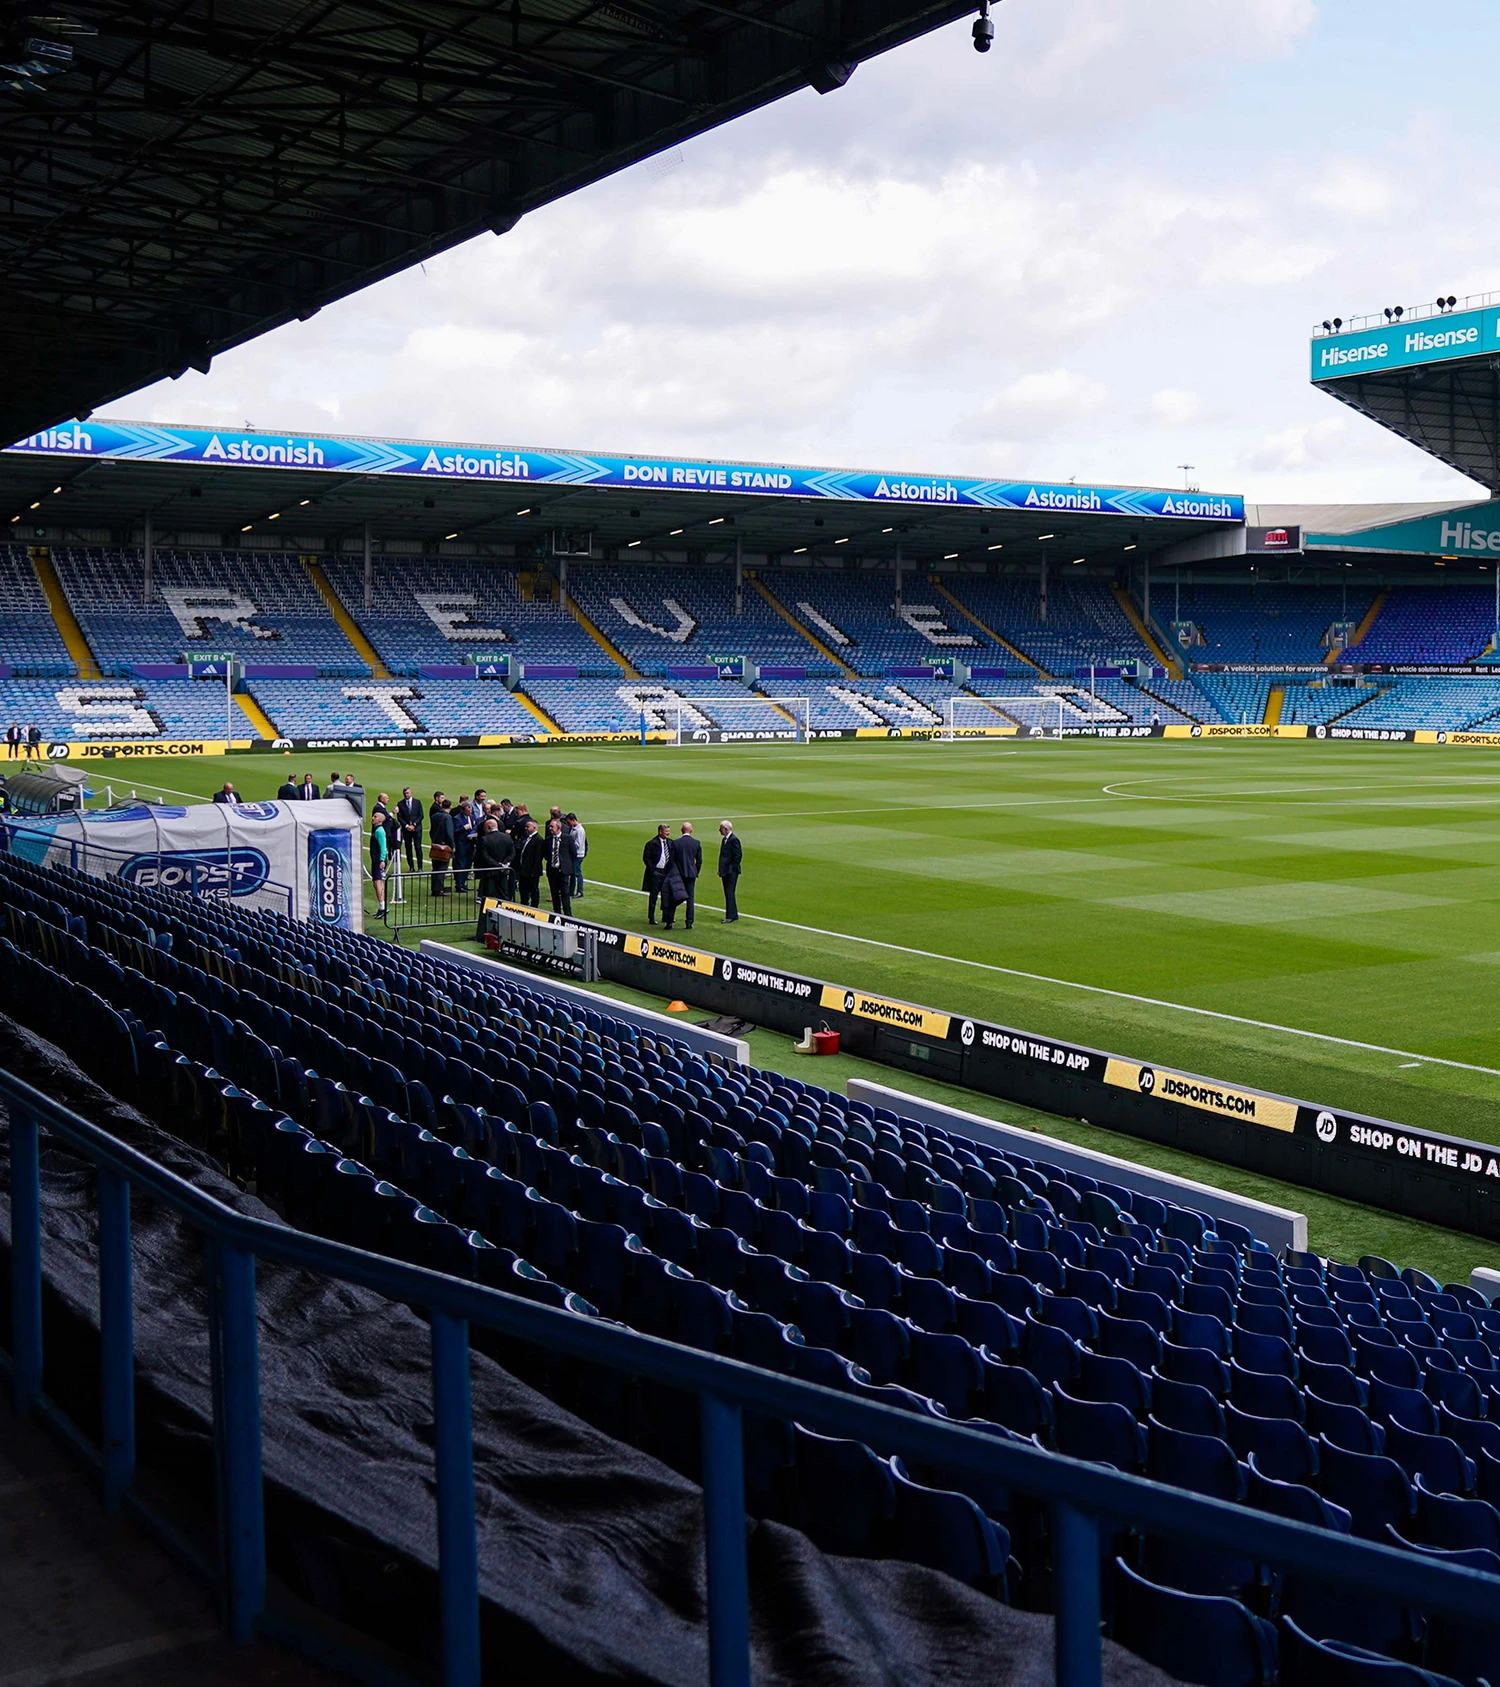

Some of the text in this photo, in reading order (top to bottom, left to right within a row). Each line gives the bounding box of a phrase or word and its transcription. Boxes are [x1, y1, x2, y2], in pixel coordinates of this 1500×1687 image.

[1404, 327, 1478, 353] Hisense
[1321, 342, 1388, 367] Hisense
[202, 434, 325, 465] Astonish
[421, 449, 529, 480] Astonish
[624, 464, 792, 491] DON REVIE STAND
[874, 478, 957, 501] Astonish
[1025, 487, 1102, 510] Astonish
[1162, 496, 1231, 518] Astonish
[1256, 665, 1284, 673] solution
[1285, 665, 1295, 673] for
[1297, 666, 1328, 674] everyone
[1418, 666, 1440, 674] solution
[1449, 667, 1472, 675] everyone
[1331, 728, 1406, 741] SHOP ON THE JD APP
[81, 744, 204, 757] JDSPORTS.COM
[135, 861, 254, 887] BOOST
[324, 853, 335, 917] BOOST
[652, 946, 697, 966] JDSPORTS.COM
[737, 967, 811, 997] SHOP ON THE JD APP
[859, 999, 923, 1027] JDSPORTS.COM
[982, 1030, 1010, 1050] SHOP
[1012, 1036, 1027, 1054] ON
[1029, 1039, 1049, 1061] THE
[1051, 1044, 1065, 1065] JD
[1066, 1049, 1090, 1070] APP
[1162, 1078, 1255, 1116] JDSPORTS.COM
[1350, 1125, 1393, 1150] SHOP
[1397, 1137, 1421, 1158] ON
[1424, 1143, 1458, 1168] THE
[1461, 1153, 1482, 1173] JD
